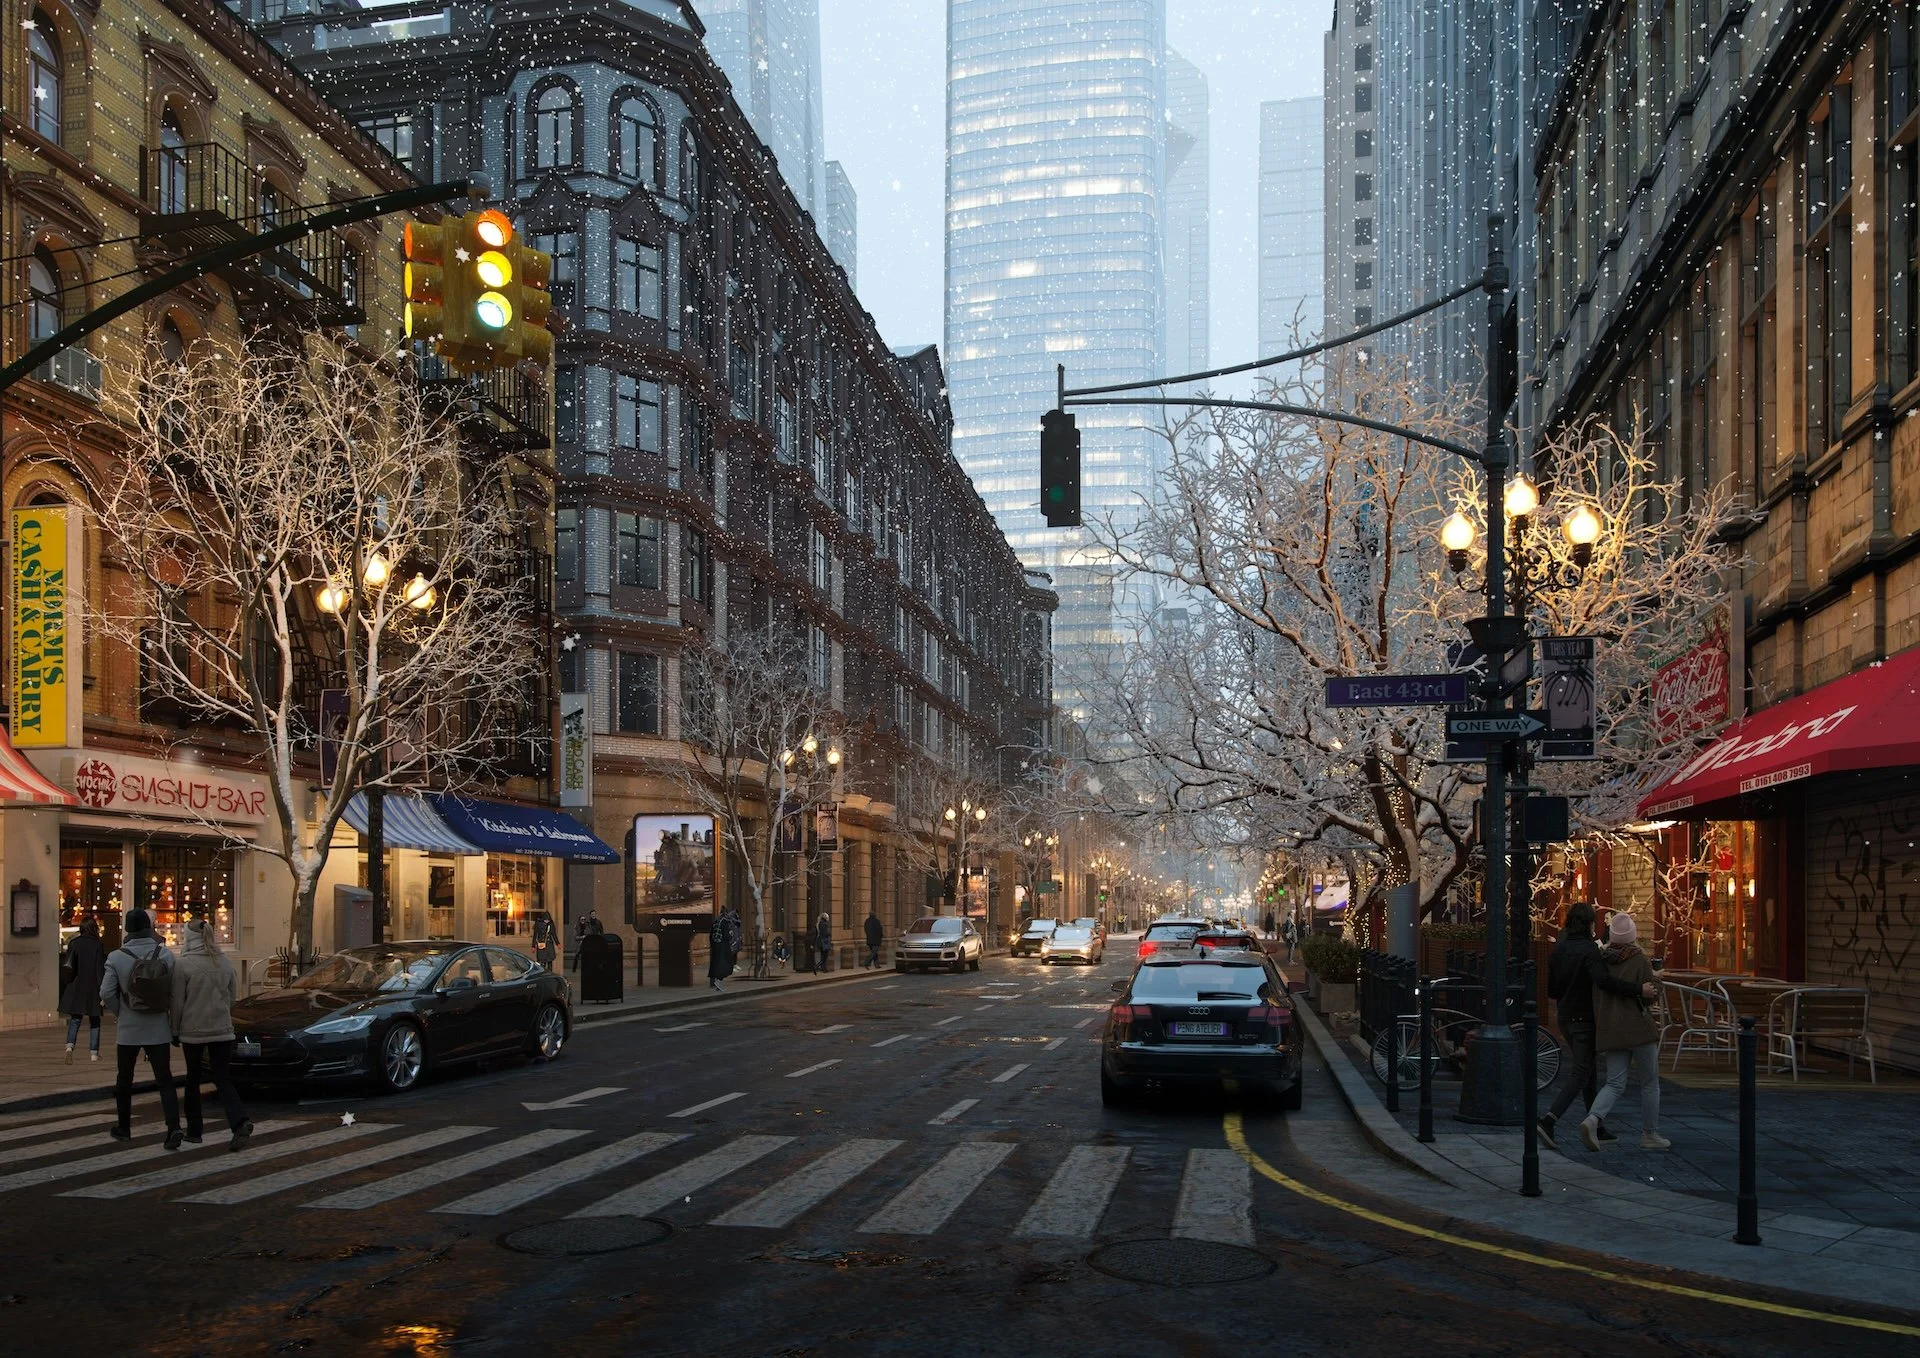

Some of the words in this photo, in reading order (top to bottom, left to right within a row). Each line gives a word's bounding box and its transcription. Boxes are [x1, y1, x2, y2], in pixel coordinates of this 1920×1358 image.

[21, 520, 42, 600] CASH
[21, 607, 41, 625] &
[43, 568, 64, 685] NORM'S
[1550, 642, 1565, 656] THIS
[21, 629, 42, 734] CARRY
[1348, 683, 1392, 699] East
[1399, 681, 1447, 698] 43rd
[1456, 721, 1491, 732] ONE
[1495, 720, 1532, 732] WAY
[1741, 780, 1755, 791] TEL.
[1755, 775, 1772, 788] 0161
[1772, 770, 1788, 783] 408
[1789, 765, 1810, 779] 7993
[478, 817, 531, 836] Kitchens
[529, 825, 544, 838] &
